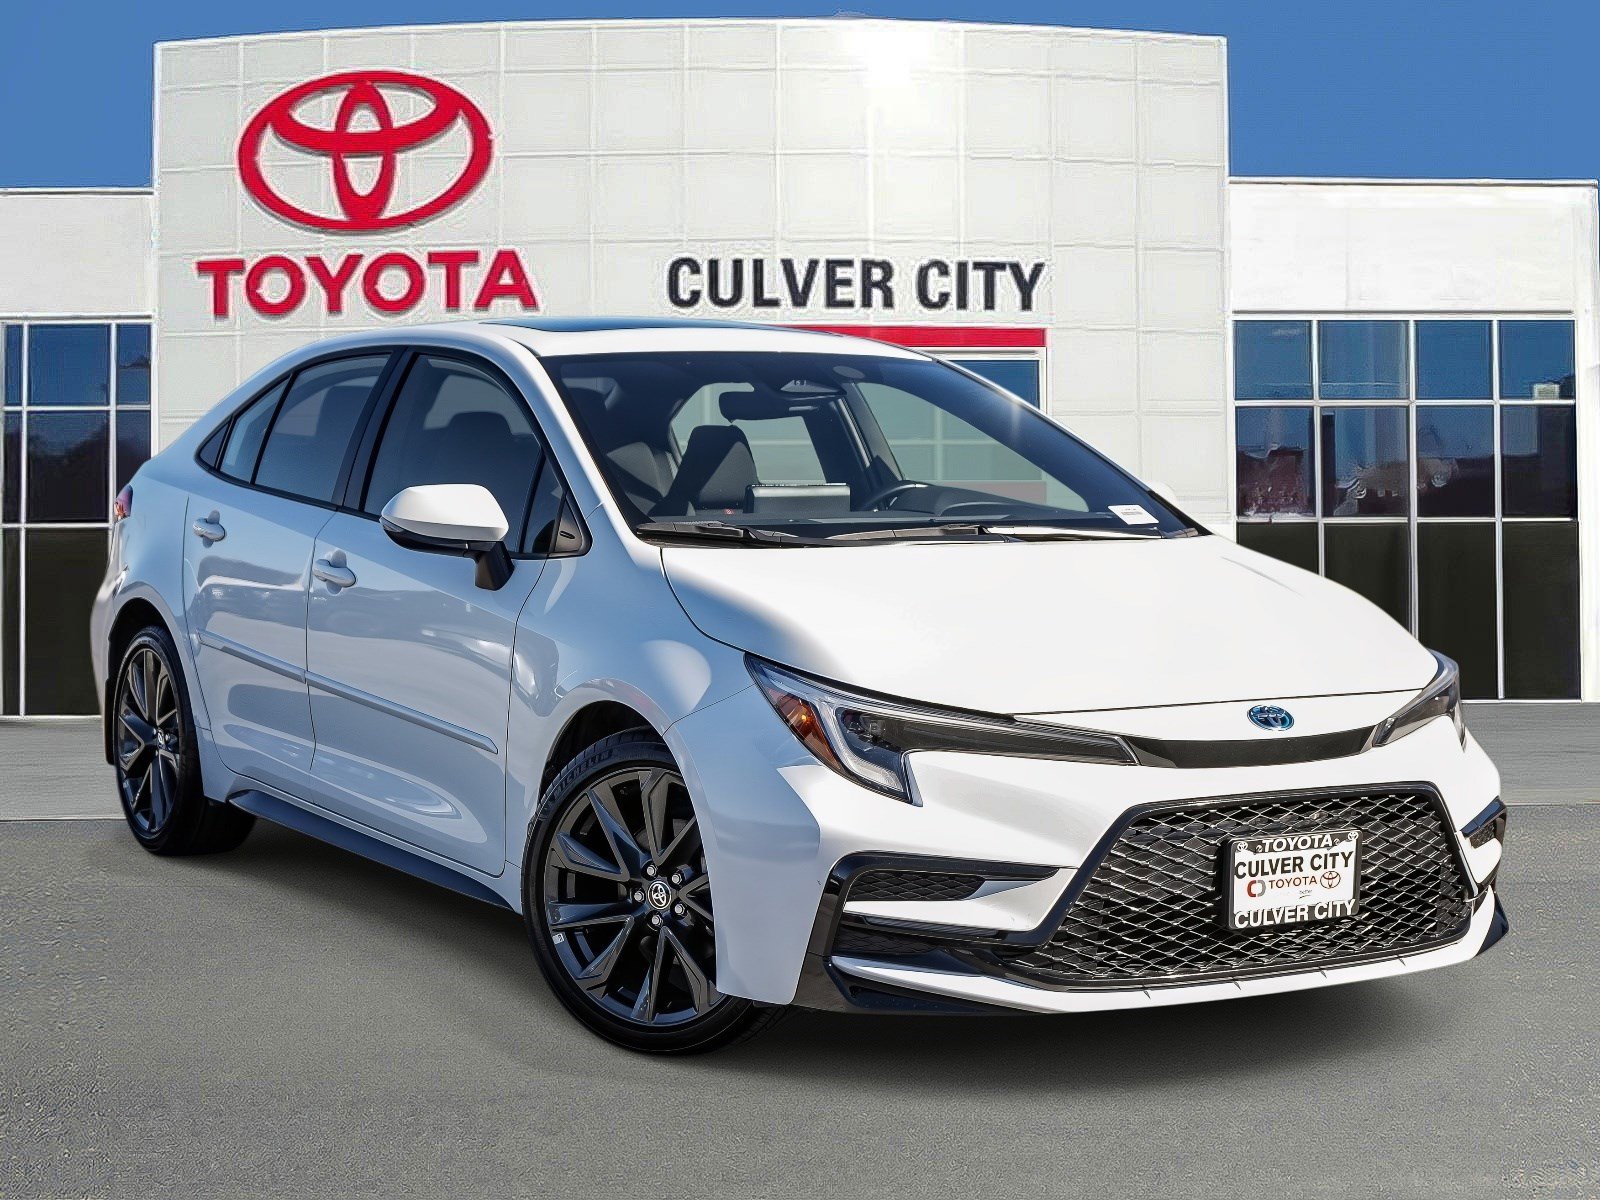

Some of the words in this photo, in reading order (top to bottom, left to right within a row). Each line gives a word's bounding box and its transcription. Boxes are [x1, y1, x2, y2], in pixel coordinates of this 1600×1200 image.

[196, 250, 539, 318] TOYOTA
[668, 258, 895, 309] CULVER
[916, 260, 1045, 311] CITY
[1262, 834, 1332, 852] TOYOTA
[1234, 856, 1303, 879] CULVER
[1309, 851, 1354, 871] CITY
[1268, 875, 1317, 889] TOYOTA
[1234, 904, 1309, 928] CULVER
[1314, 899, 1356, 920] CITY
